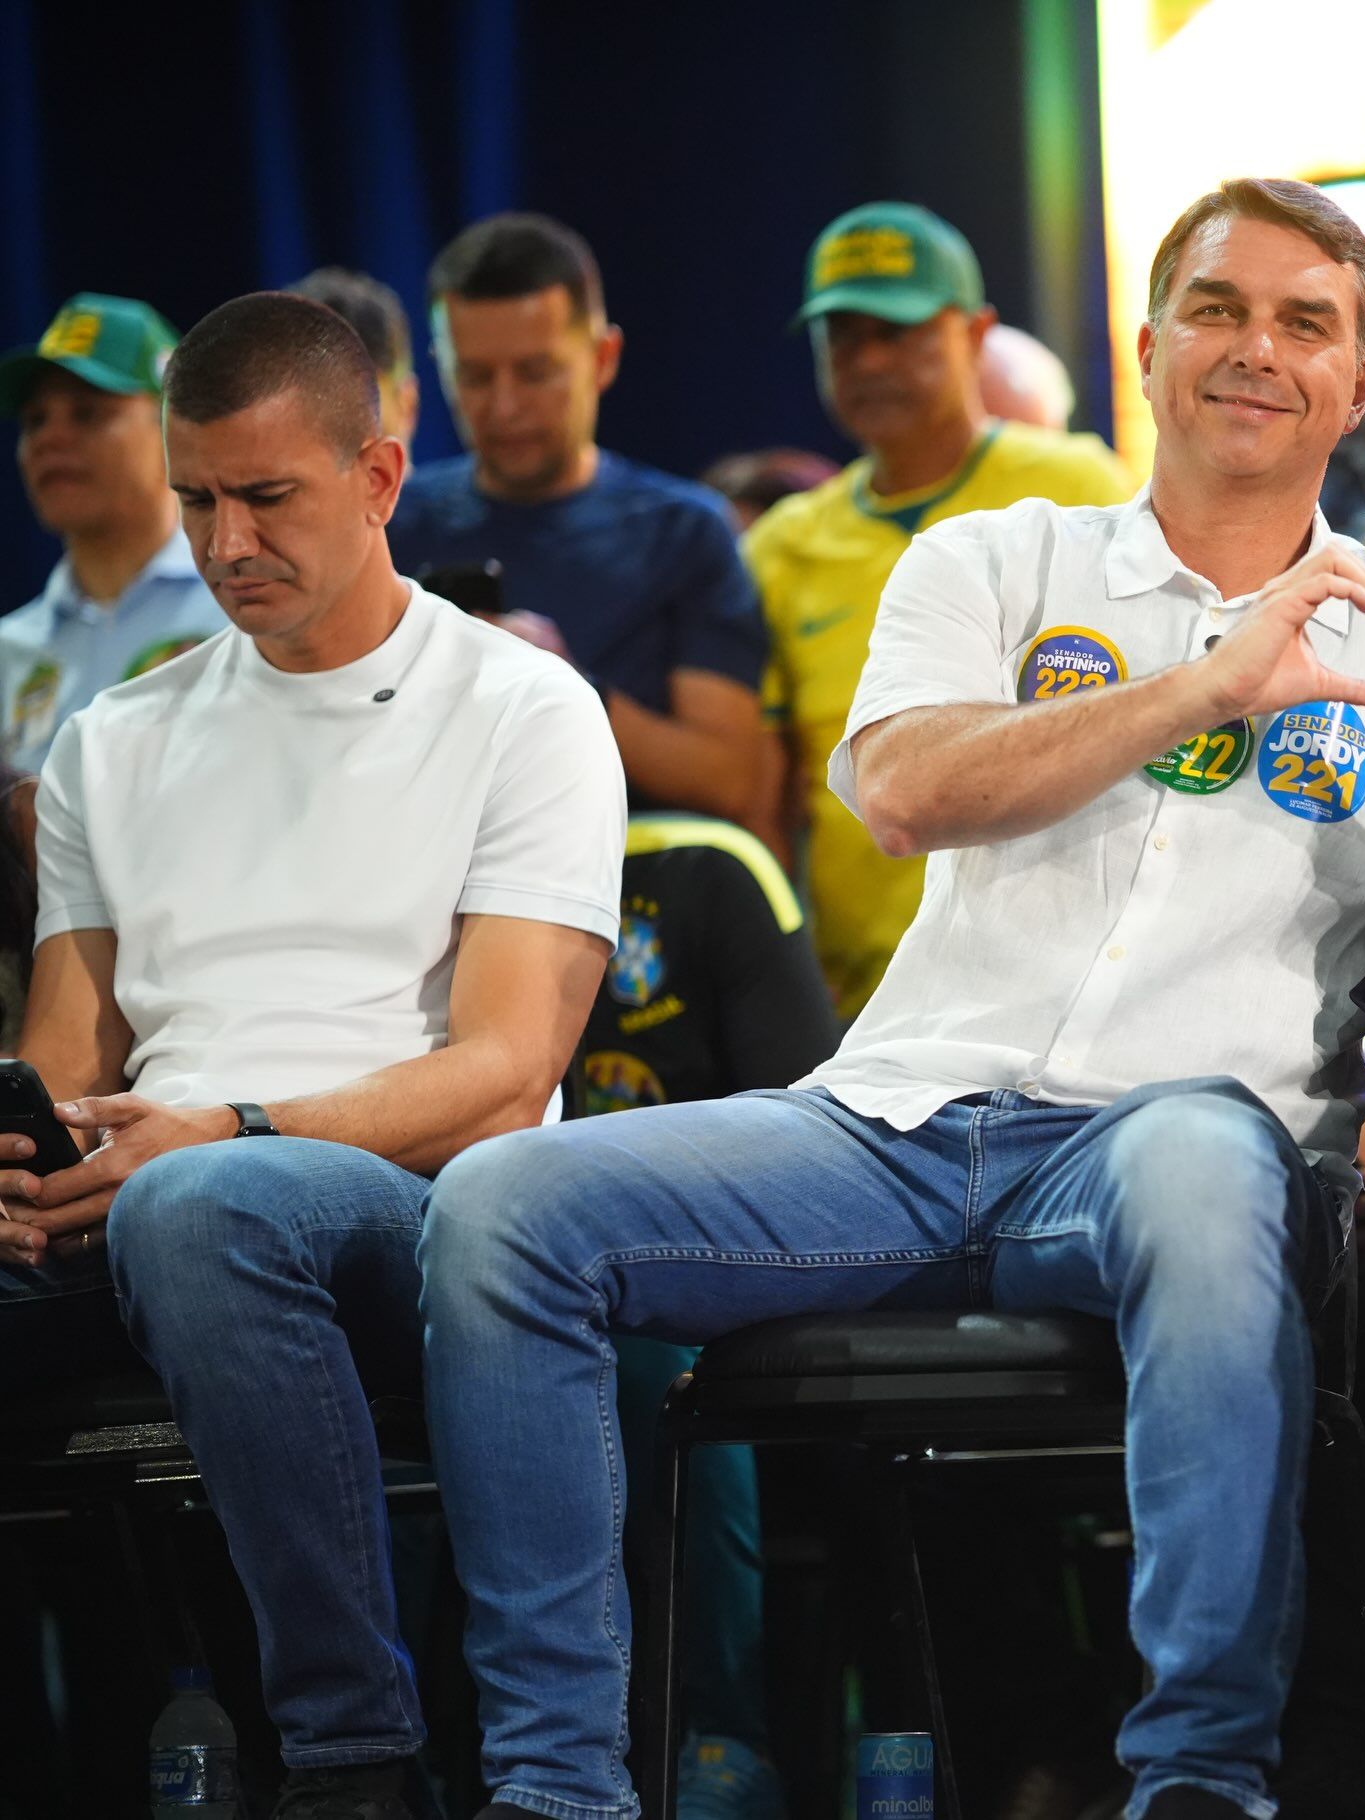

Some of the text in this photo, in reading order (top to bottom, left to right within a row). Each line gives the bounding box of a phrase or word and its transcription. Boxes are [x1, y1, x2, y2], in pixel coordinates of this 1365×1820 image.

[1037, 653, 1111, 674] PORTINHO
[1054, 649, 1094, 660] SENADOR
[1179, 732, 1236, 781] 22
[1268, 753, 1357, 811] 221
